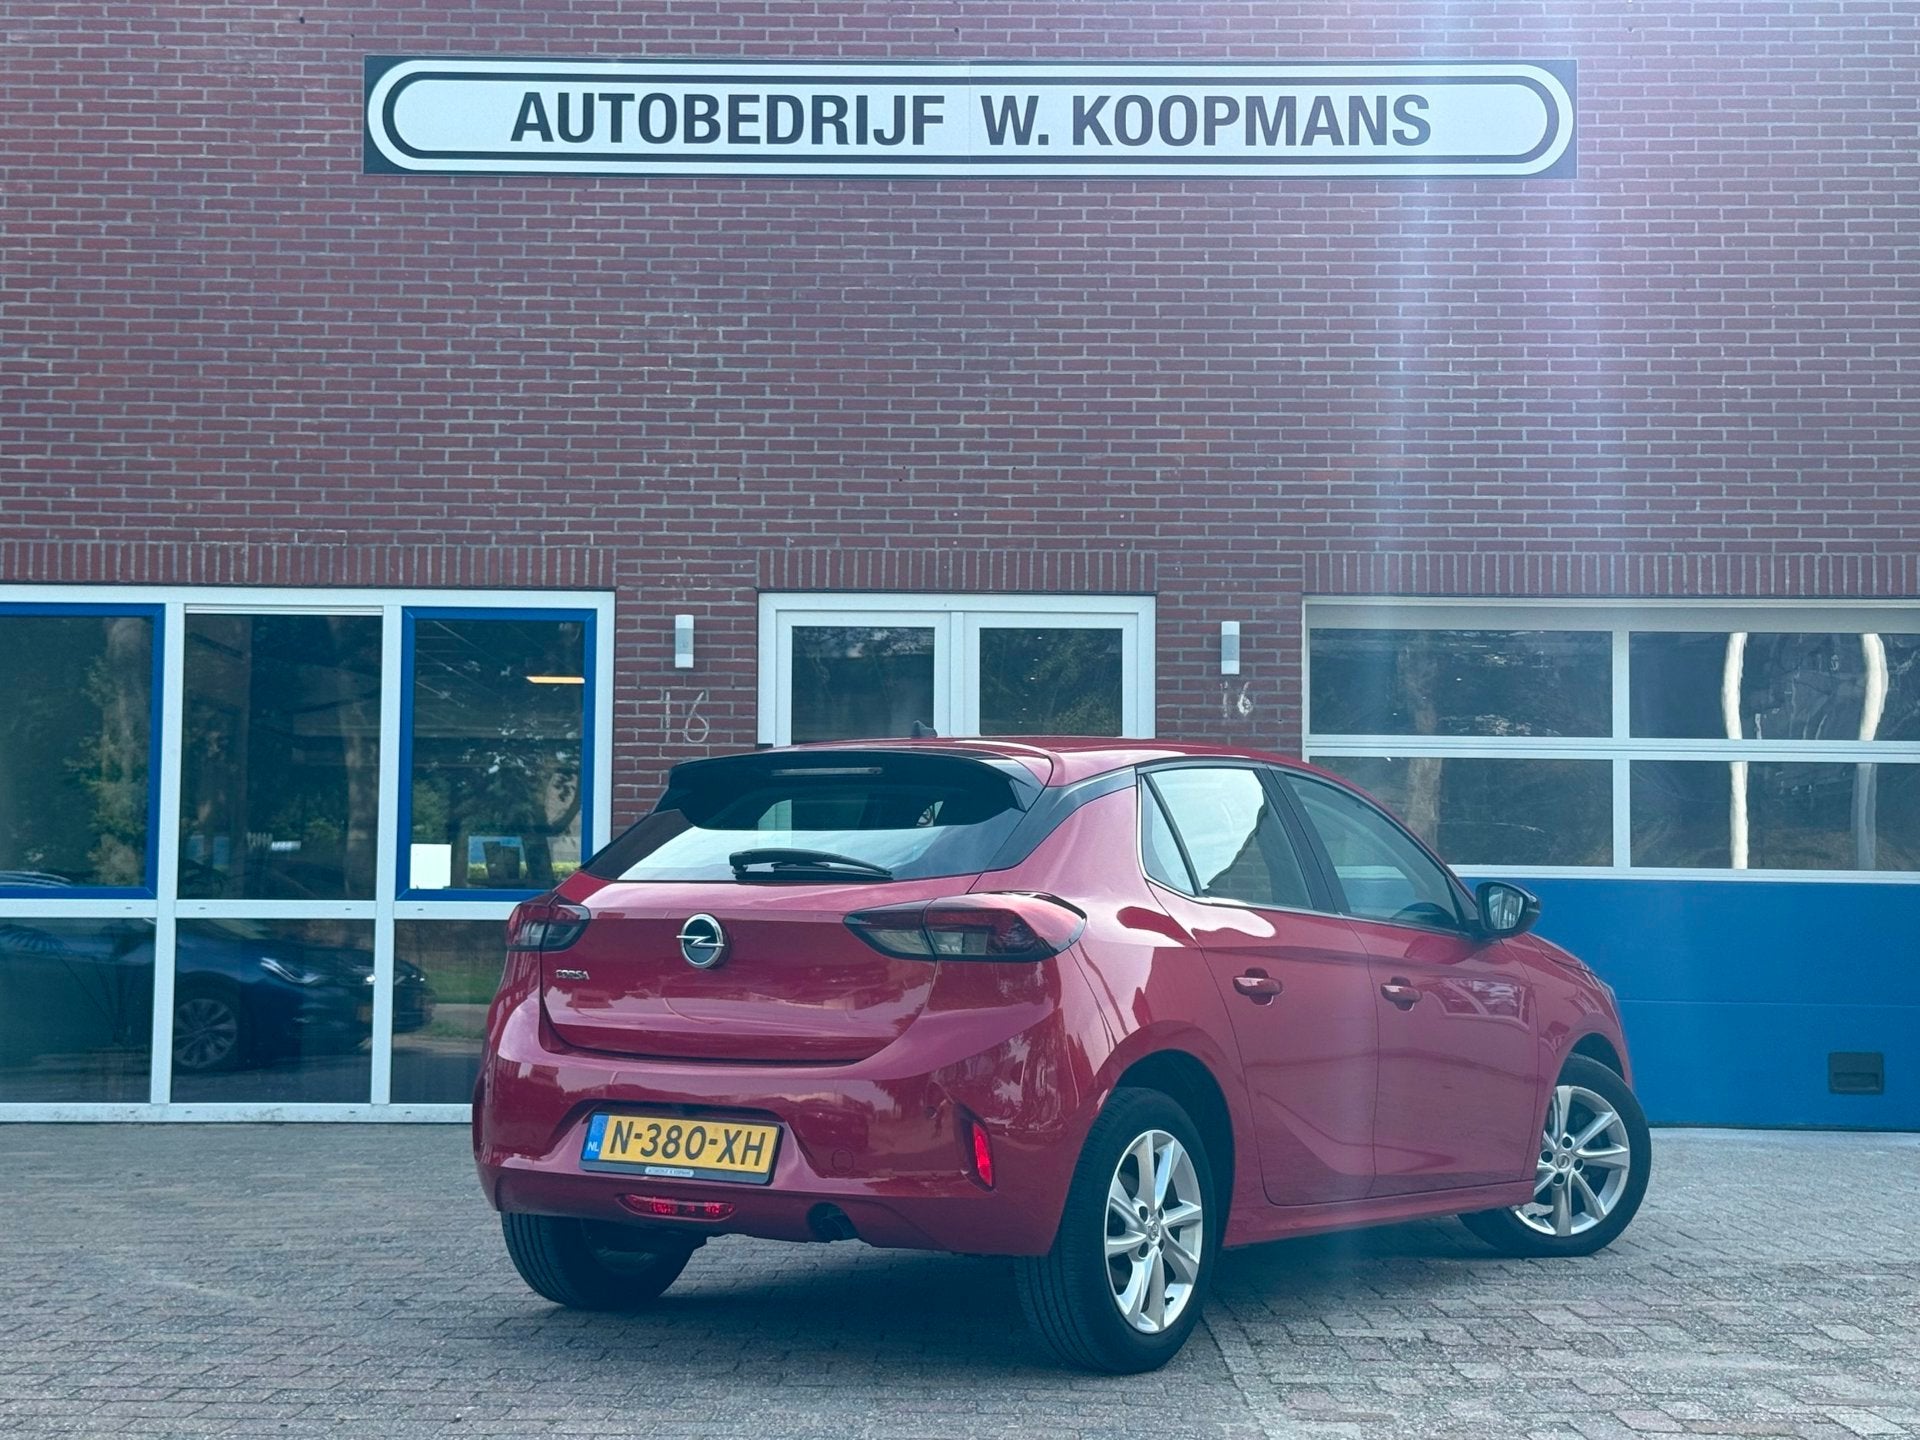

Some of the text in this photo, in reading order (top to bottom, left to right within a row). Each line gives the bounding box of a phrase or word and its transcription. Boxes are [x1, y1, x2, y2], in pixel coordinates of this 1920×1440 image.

[510, 91, 1432, 147] AUTOBEDRIJF W. KOOPMANS
[665, 691, 710, 743] 16
[587, 1141, 599, 1152] NL
[609, 1120, 766, 1166] N-380-XH
